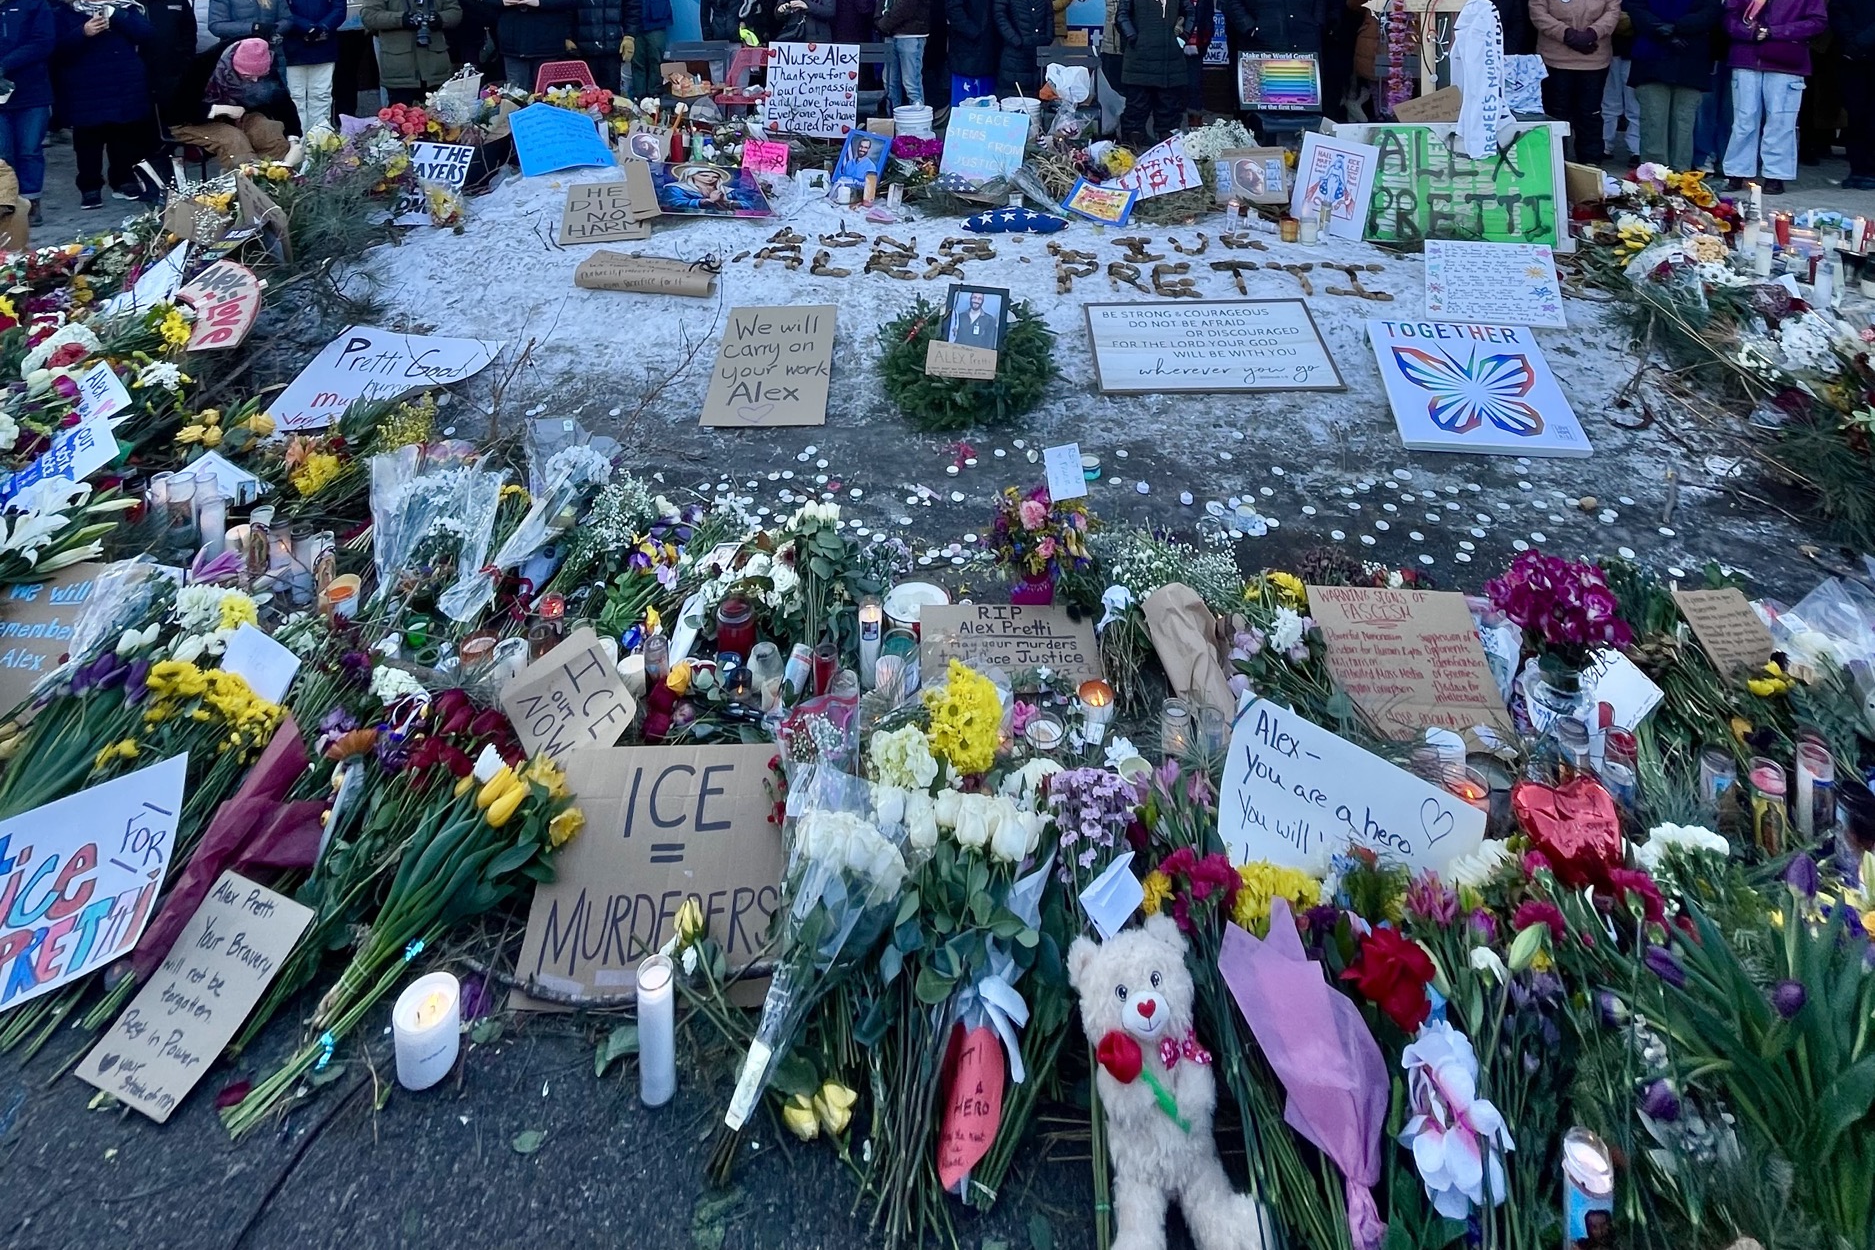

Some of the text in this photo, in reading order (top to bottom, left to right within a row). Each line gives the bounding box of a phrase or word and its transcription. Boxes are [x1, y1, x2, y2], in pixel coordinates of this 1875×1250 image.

[777, 45, 858, 66] Nurse Alex
[1293, 52, 1314, 60] Great!
[769, 66, 846, 84] Thank you for
[769, 81, 798, 97] Your
[769, 96, 856, 108] and Love toward
[768, 107, 856, 123] Everyone You have
[968, 112, 1011, 127] PEACE
[636, 125, 667, 136] ALEX
[785, 117, 820, 132] Cared
[948, 127, 987, 141] STEMS
[432, 145, 473, 164] THE
[986, 142, 1024, 157] FROM
[953, 155, 1004, 171] JUSTIC
[414, 162, 466, 185] AYERS
[587, 186, 624, 198] HE
[570, 198, 632, 213] DID
[586, 209, 627, 223] NO
[567, 220, 645, 237] HARM
[1102, 311, 1118, 319] BE
[1121, 310, 1172, 319] STRONG
[1183, 308, 1269, 318] COURAGEOUS
[734, 313, 819, 340] We will
[1128, 318, 1246, 328] DO NOT BE AFRAID
[1185, 327, 1299, 338] OR DISCOURAGED
[1381, 321, 1520, 344] TOGETHER
[1112, 338, 1278, 348] FOR THE LORD YOUR GOD
[334, 337, 479, 378] Pretti Good
[723, 340, 814, 366] carry on
[934, 350, 967, 365] ALEX
[1173, 348, 1297, 358] WILL BE WITH YOU
[721, 360, 829, 388] your work
[1138, 357, 1320, 384] wherever you go
[726, 381, 801, 406] Alex
[1316, 587, 1429, 605] WARNING SIGNS OF
[1340, 603, 1415, 620] FASCISM
[959, 619, 1052, 636] Alex Pretti
[981, 640, 1013, 653] your
[1016, 639, 1078, 651] murders
[1015, 650, 1084, 665] Justice
[562, 648, 627, 740] ICE
[550, 689, 576, 721] OUT
[516, 695, 577, 760] NOW
[1242, 745, 1286, 790] You
[1293, 783, 1328, 808] are
[1335, 804, 1356, 829] a
[623, 764, 735, 839] ICE
[1237, 789, 1310, 854] You will
[119, 812, 168, 867] FOR
[212, 879, 275, 920] Alex Pretti
[536, 885, 784, 976] MURDEERS
[195, 915, 275, 980] Your Bravery
[162, 955, 226, 997] will not be
[116, 1008, 200, 1070] Rest in Power
[974, 1080, 984, 1095] A
[953, 1096, 990, 1119] HERO
